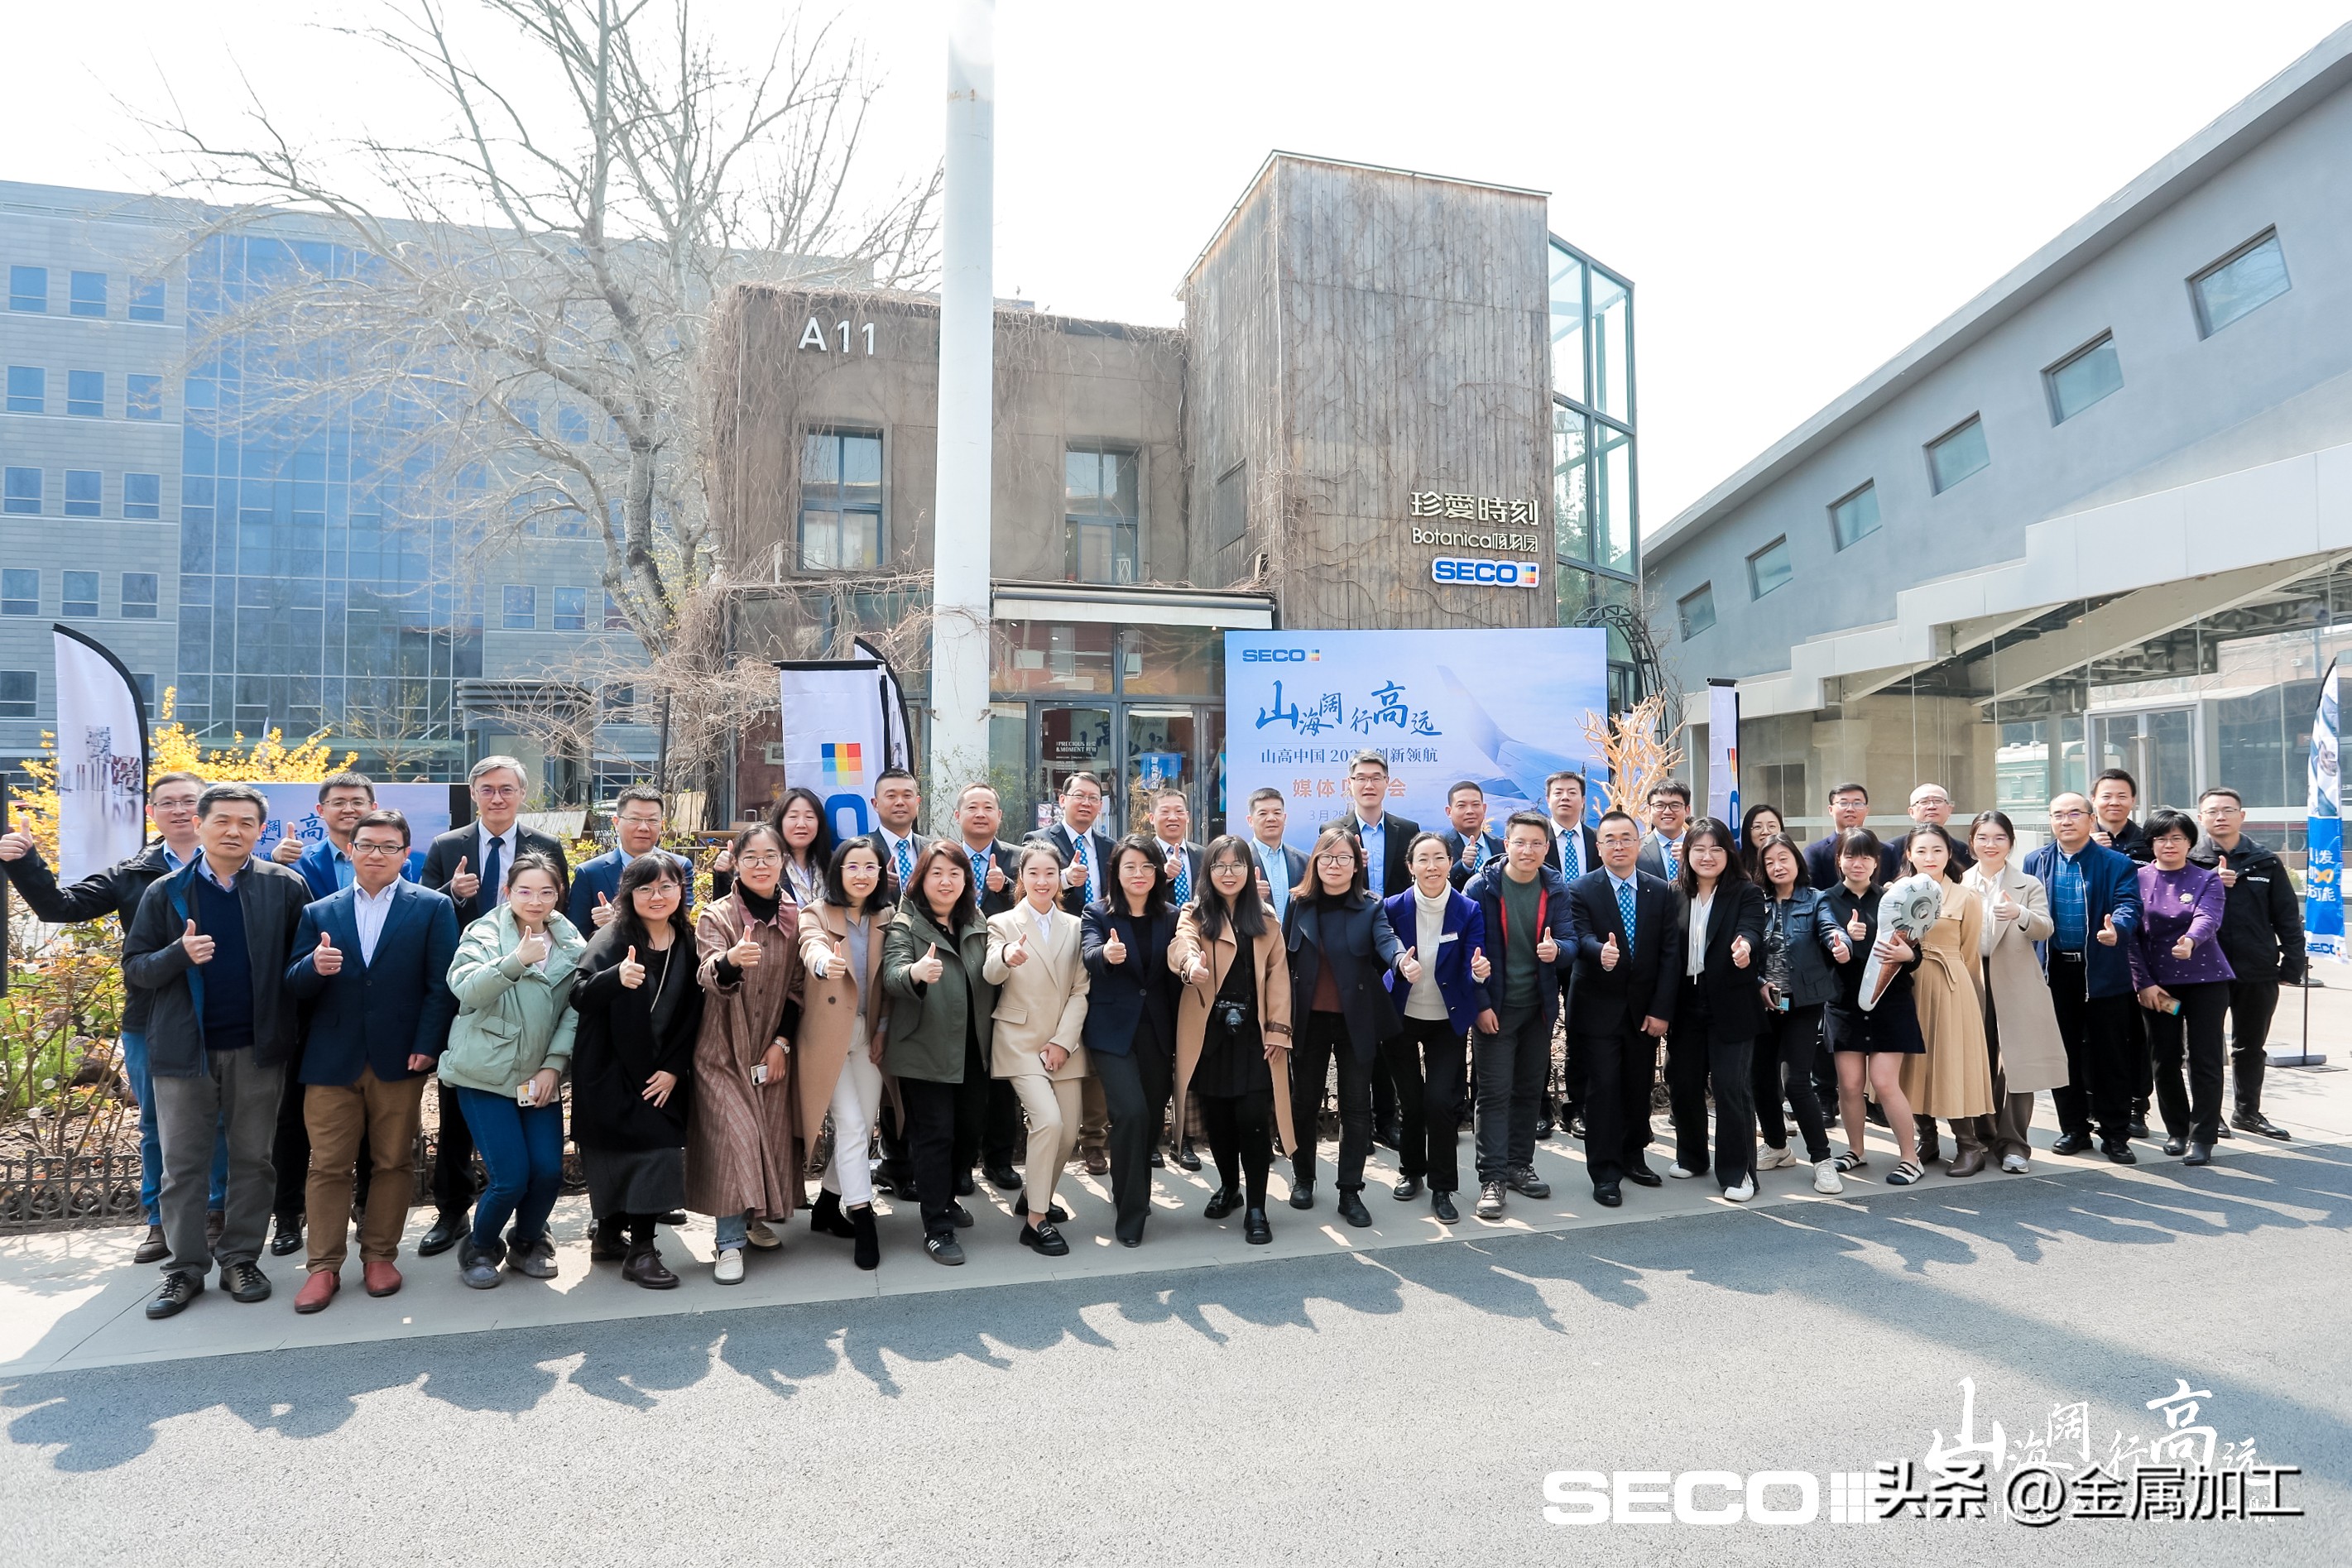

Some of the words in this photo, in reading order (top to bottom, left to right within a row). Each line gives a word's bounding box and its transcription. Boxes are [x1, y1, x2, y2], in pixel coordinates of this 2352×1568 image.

[798, 317, 874, 355] A11
[1411, 491, 1539, 525] 珍愛時刻
[1435, 561, 1518, 583] SECO
[1242, 649, 1305, 662] SECO
[1255, 680, 1442, 736] 山海阔行高远
[1261, 748, 1325, 764] 山高中国
